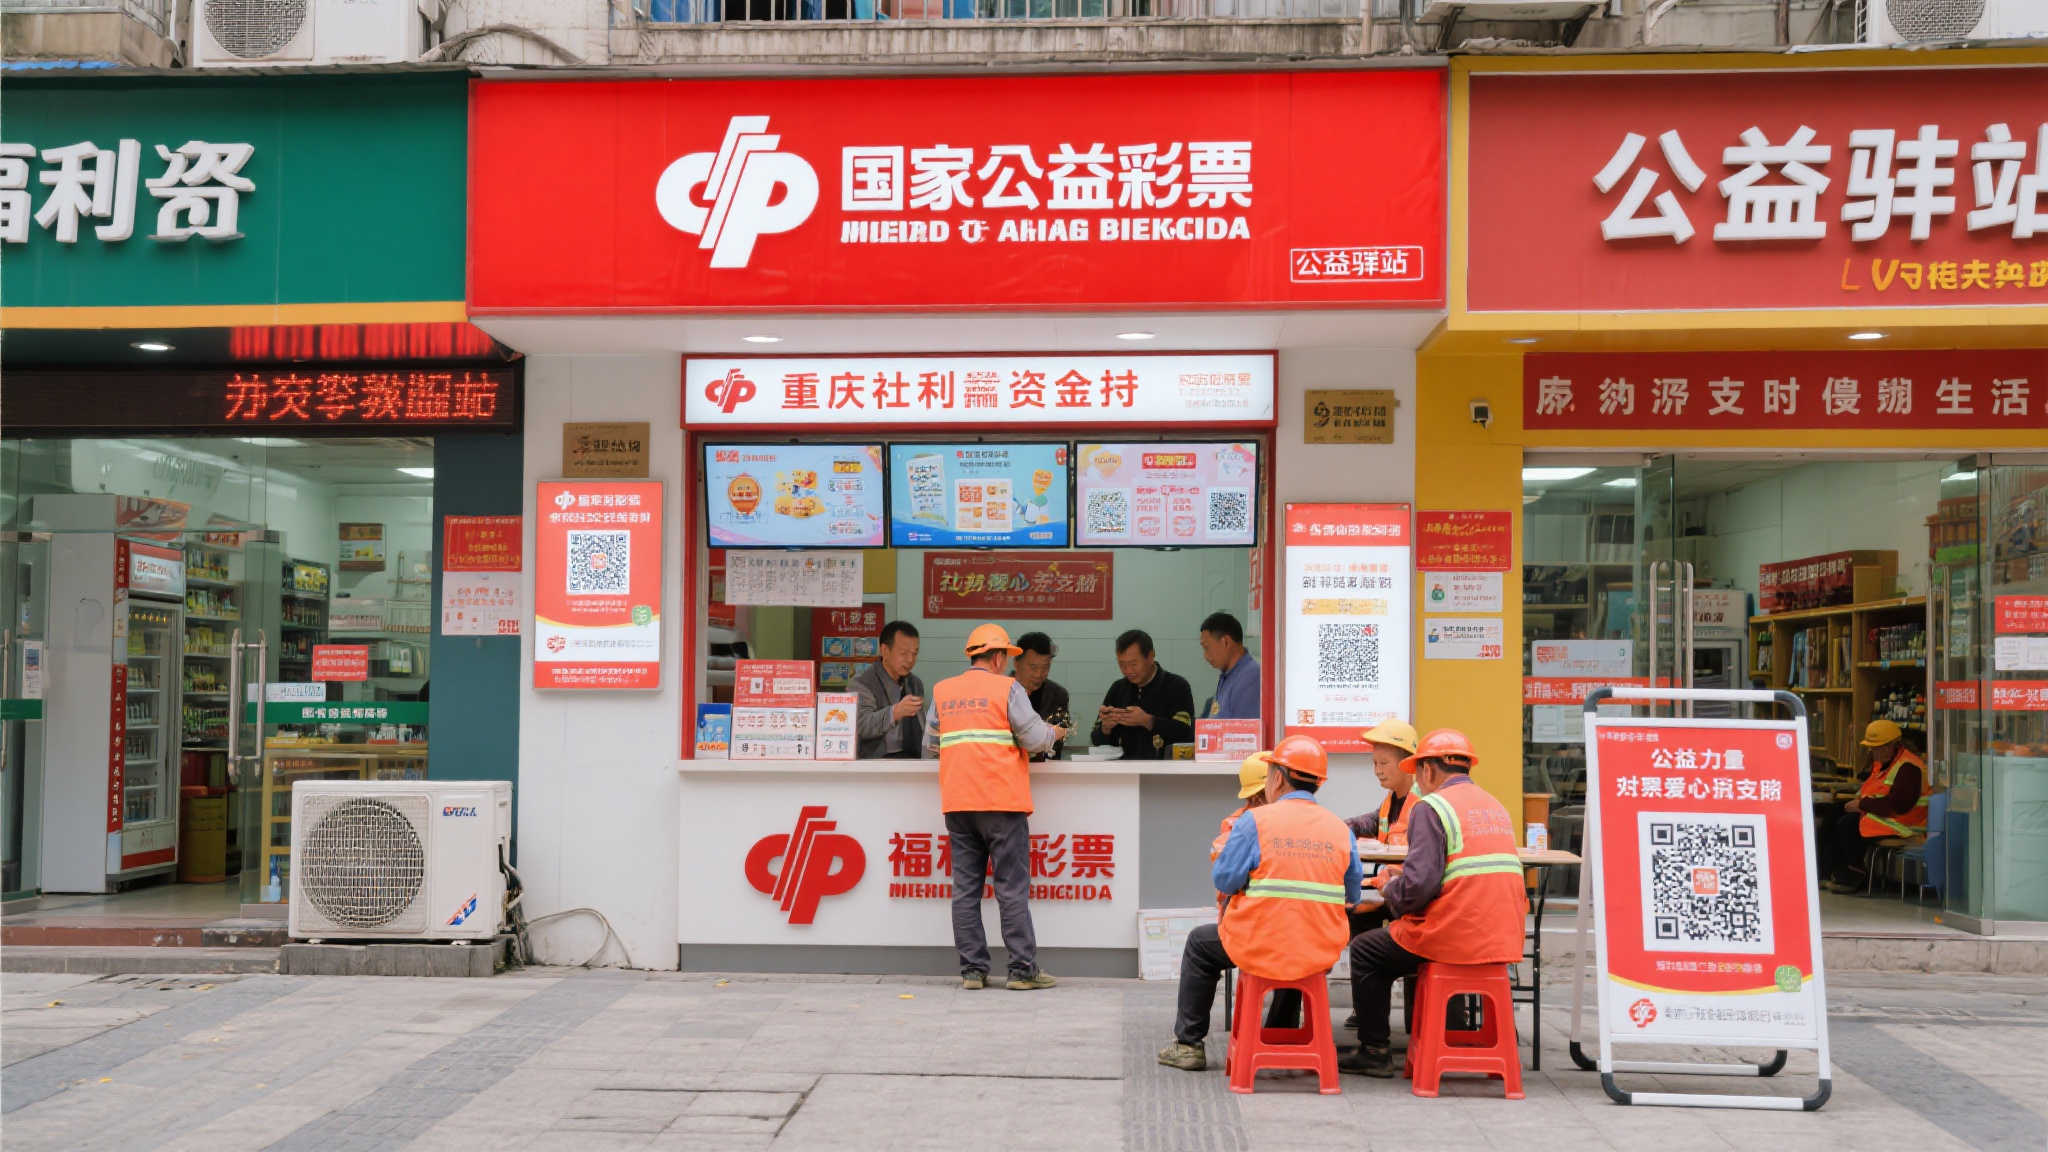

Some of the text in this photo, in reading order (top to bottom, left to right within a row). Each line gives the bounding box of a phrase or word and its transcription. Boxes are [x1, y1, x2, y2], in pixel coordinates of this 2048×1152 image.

[841, 141, 1253, 211] 国家公益彩票
[1295, 250, 1409, 276] 公益驿站
[1650, 747, 1745, 771] 公益力量
[888, 832, 1115, 879] 福彩票
